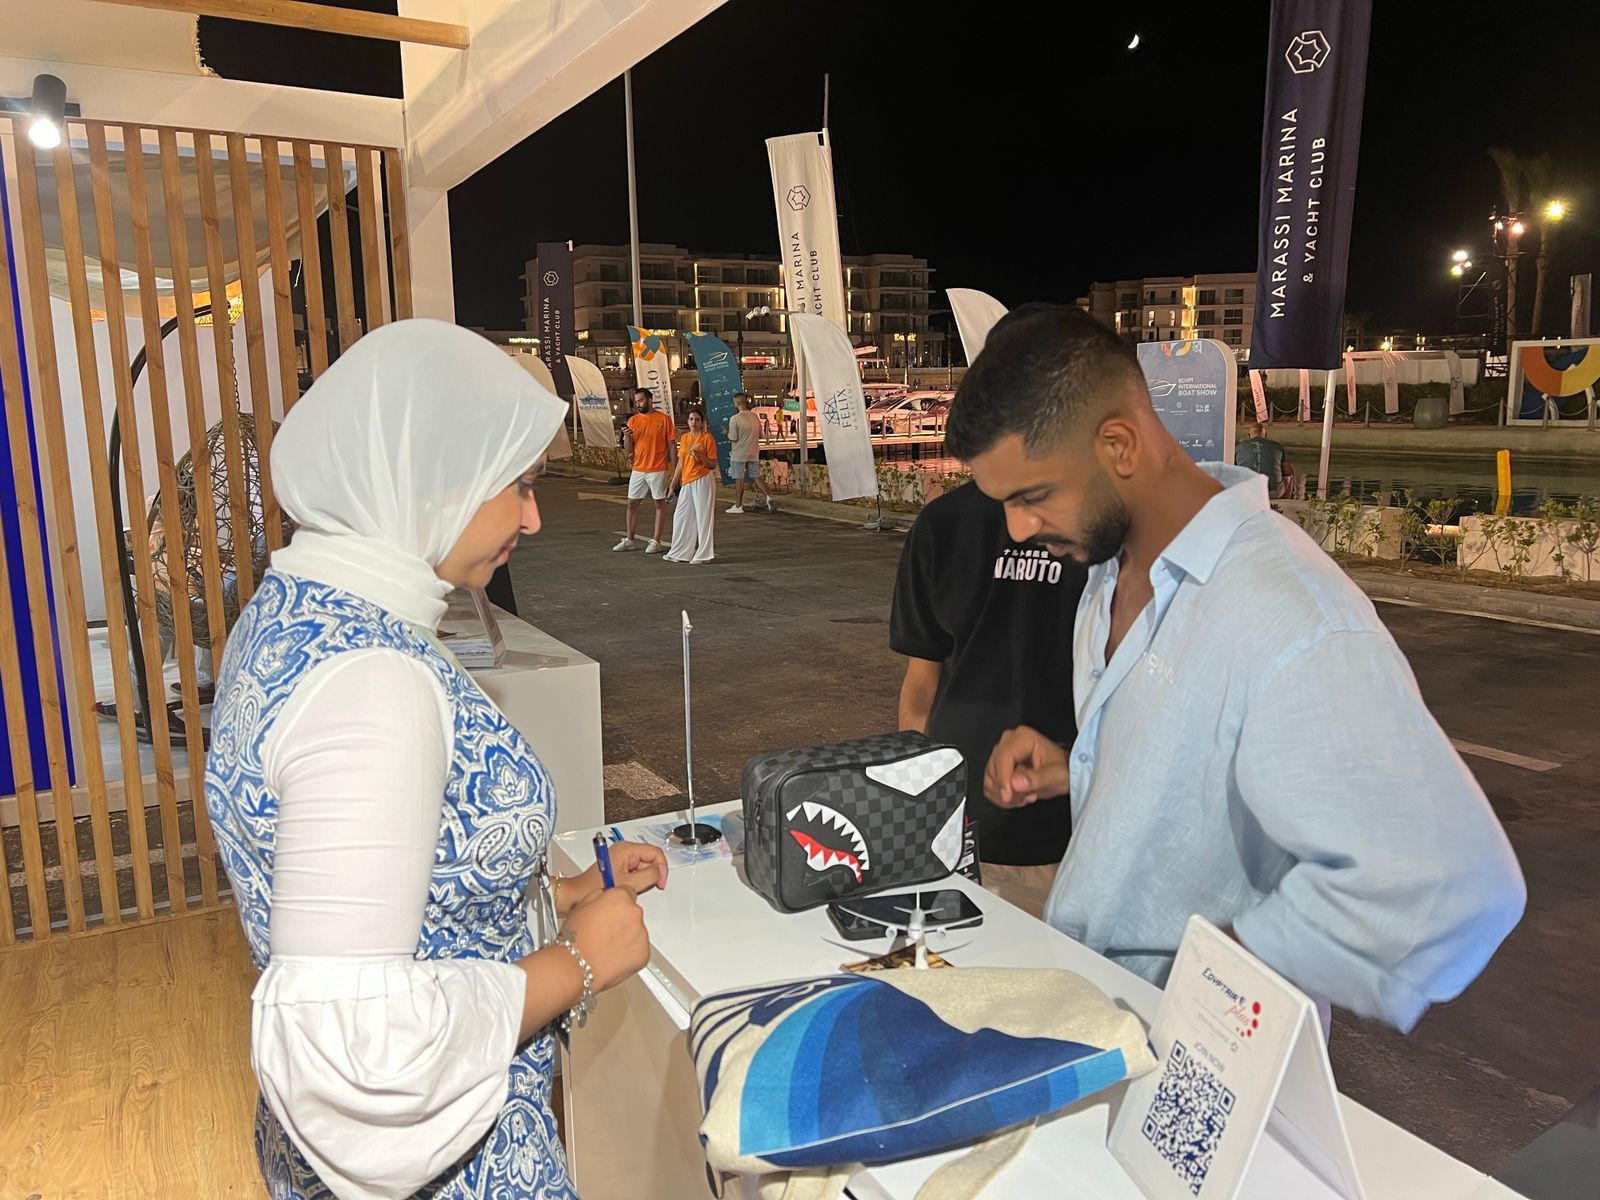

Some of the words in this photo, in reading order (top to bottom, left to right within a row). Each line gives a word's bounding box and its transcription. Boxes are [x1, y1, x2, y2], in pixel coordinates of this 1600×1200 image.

[1276, 108, 1299, 203] MARINA
[1309, 136, 1327, 190] CLUB
[1304, 198, 1321, 264] YACHT
[791, 231, 805, 290] MARINA
[809, 249, 820, 281] CLUB
[1269, 214, 1292, 318] MARASSI
[1302, 272, 1314, 283] &
[813, 286, 823, 317] ACHT
[544, 336, 552, 371] ARASSI
[839, 388, 852, 429] FELIX
[994, 557, 1062, 584] NARUTO
[1224, 1004, 1250, 1026] plus
[1208, 1052, 1226, 1073] NOW
